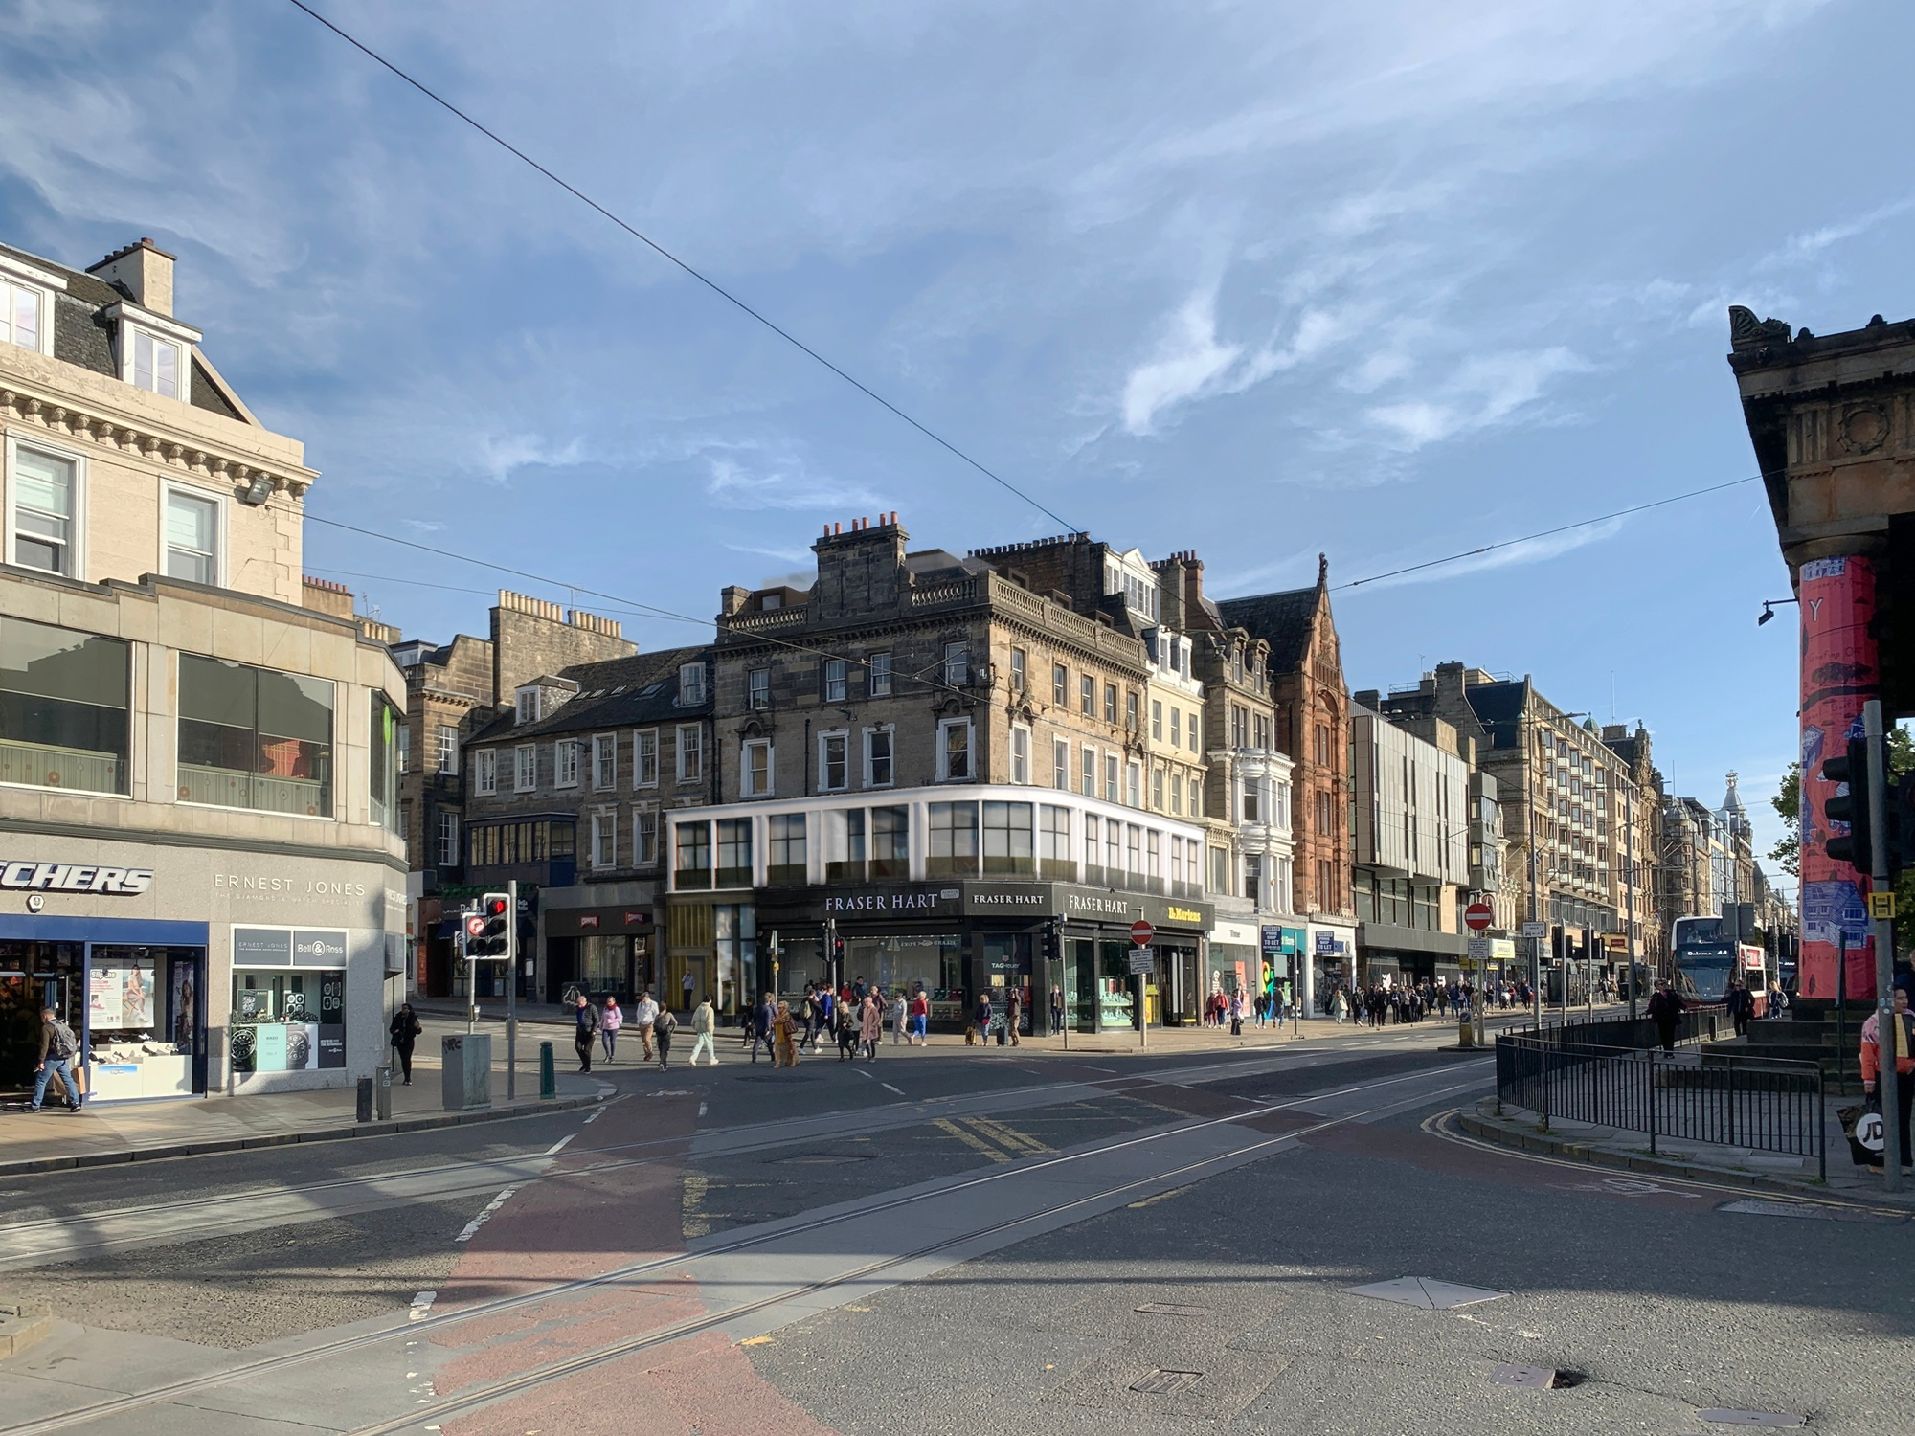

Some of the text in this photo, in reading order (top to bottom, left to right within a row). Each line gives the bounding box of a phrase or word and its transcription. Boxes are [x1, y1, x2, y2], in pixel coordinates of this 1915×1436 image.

[1809, 597, 1823, 622] Y
[0, 861, 154, 895] CHERS
[214, 874, 293, 891] ERNEST
[306, 881, 366, 896] JONES
[825, 896, 886, 911] FRASER
[891, 893, 938, 909] HART
[973, 894, 1044, 904] FRASER HART
[1069, 895, 1128, 914] FRASER HART
[297, 943, 312, 953] Bell
[325, 944, 344, 954] Ross
[1862, 1121, 1883, 1143] JD
